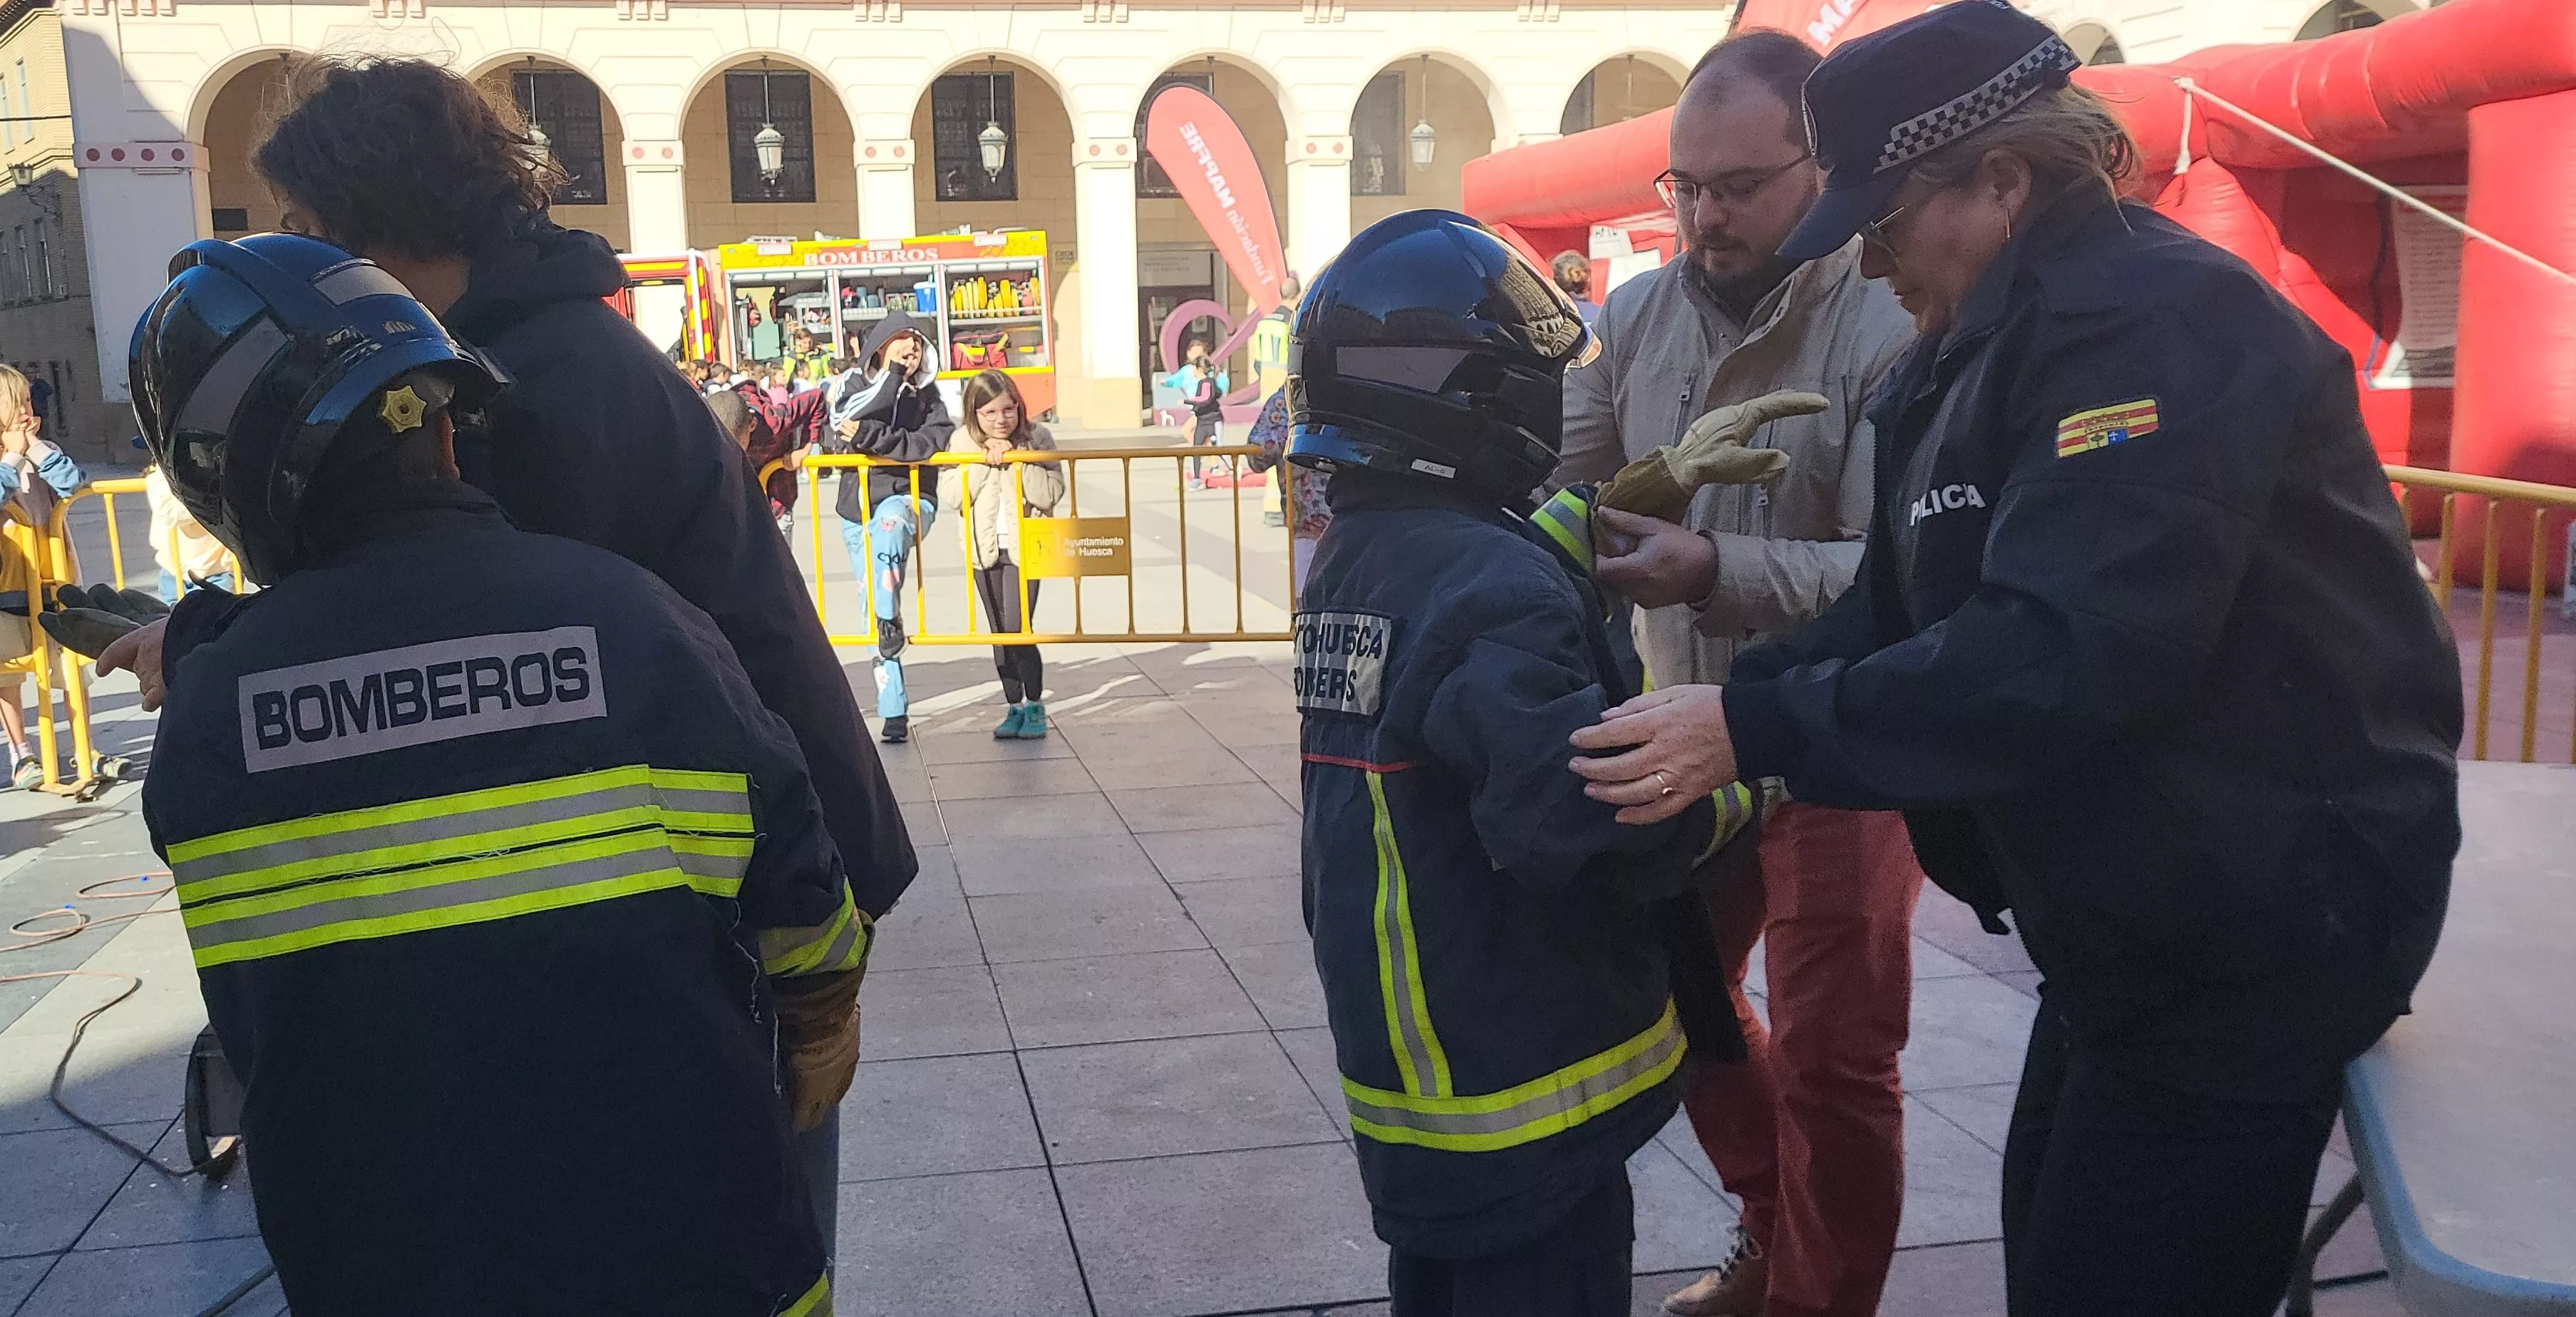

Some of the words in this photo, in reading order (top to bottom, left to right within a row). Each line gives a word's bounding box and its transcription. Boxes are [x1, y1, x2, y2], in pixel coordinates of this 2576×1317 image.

[803, 247, 939, 266] BOMBEROS
[1064, 536, 1124, 548] Ayuntamiento
[1078, 546, 1113, 557] Huesca
[252, 646, 590, 751] BOMBEROS
